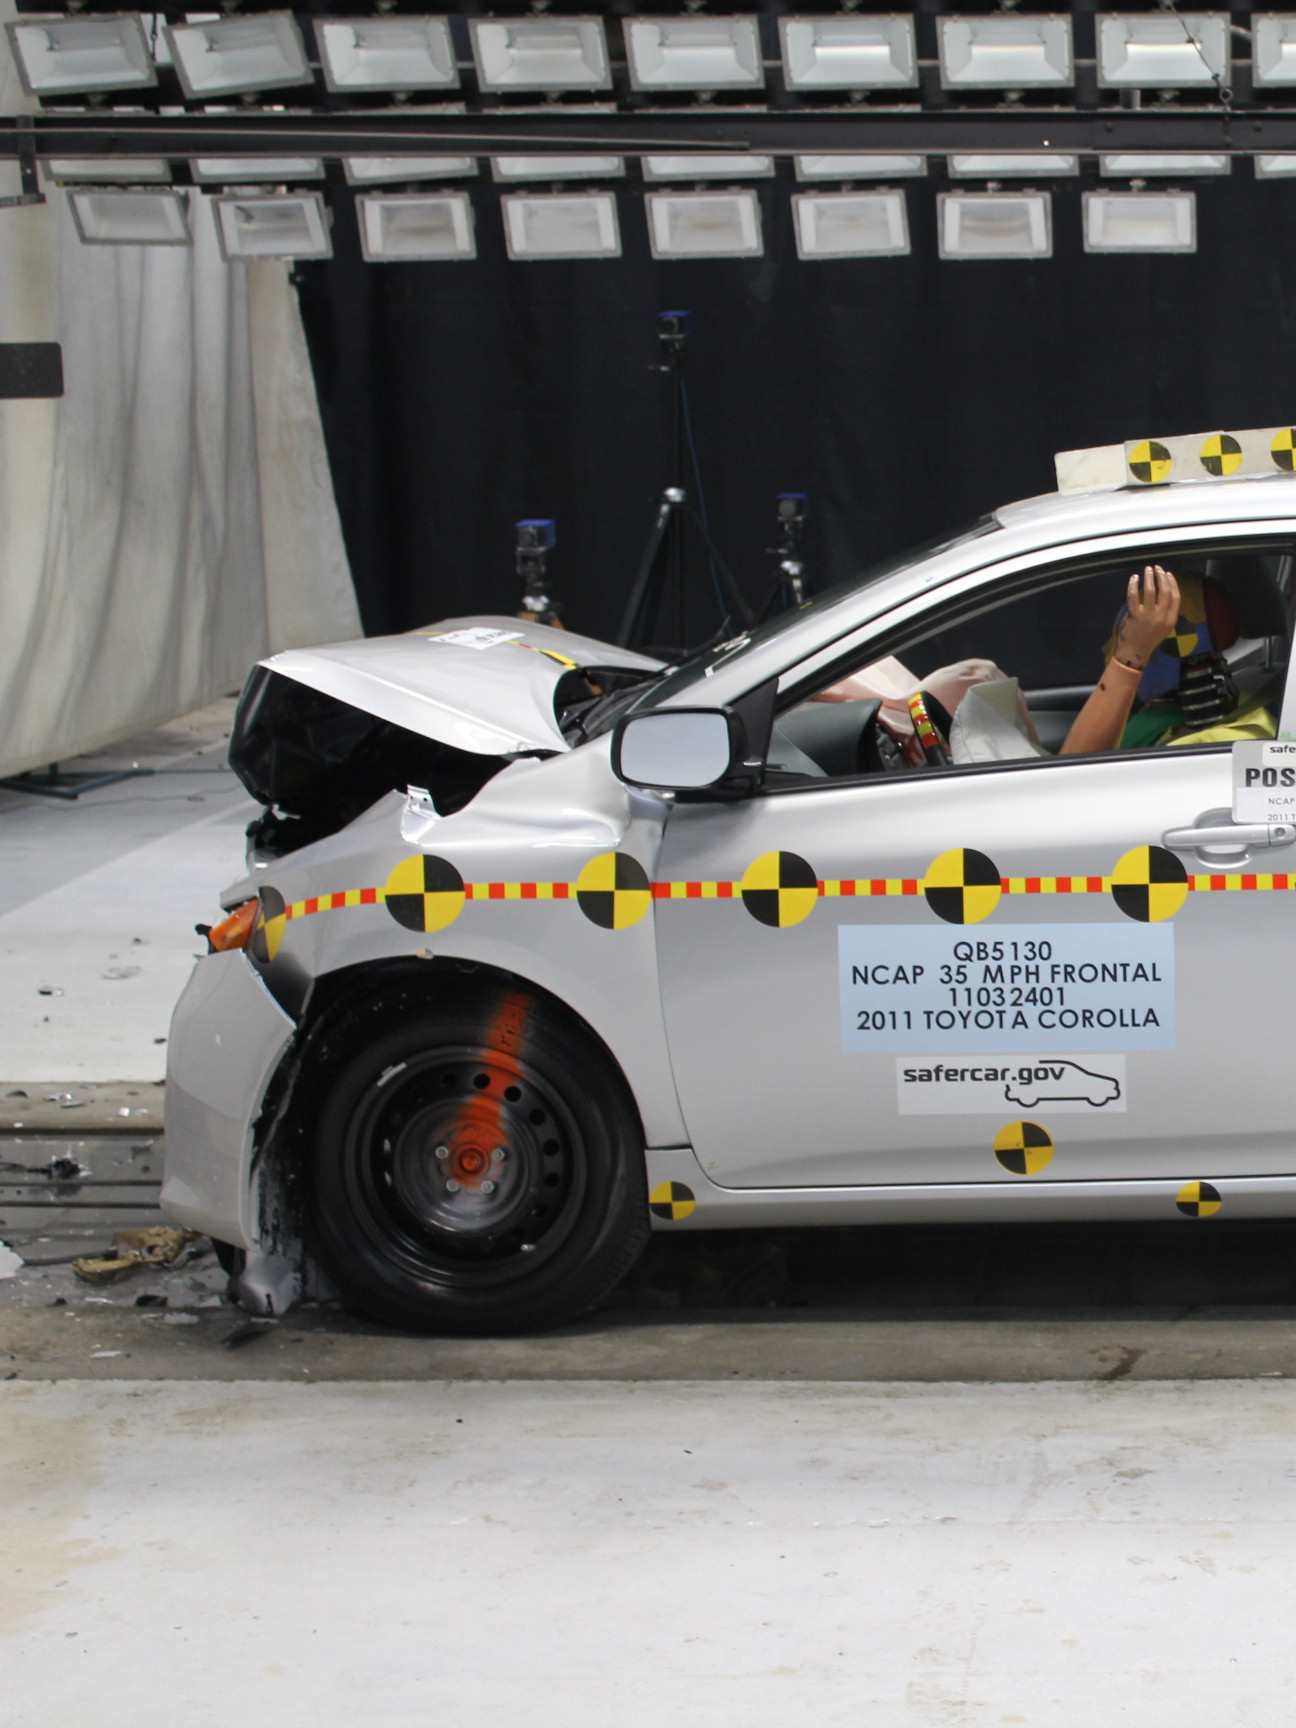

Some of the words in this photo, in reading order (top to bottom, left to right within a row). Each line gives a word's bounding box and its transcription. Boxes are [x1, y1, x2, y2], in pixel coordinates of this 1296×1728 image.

[953, 941, 1052, 963] QB5130
[852, 965, 925, 985] NCAP
[939, 965, 968, 984] 35
[982, 964, 1040, 984] MPH
[1050, 963, 1162, 983] FRONTAL
[949, 987, 1065, 1007] 11032401
[857, 1011, 912, 1031] 2011
[924, 1010, 1029, 1030] TOYOTA
[1038, 1008, 1160, 1029] COROLLA
[903, 1064, 1066, 1086] safercar.gov
